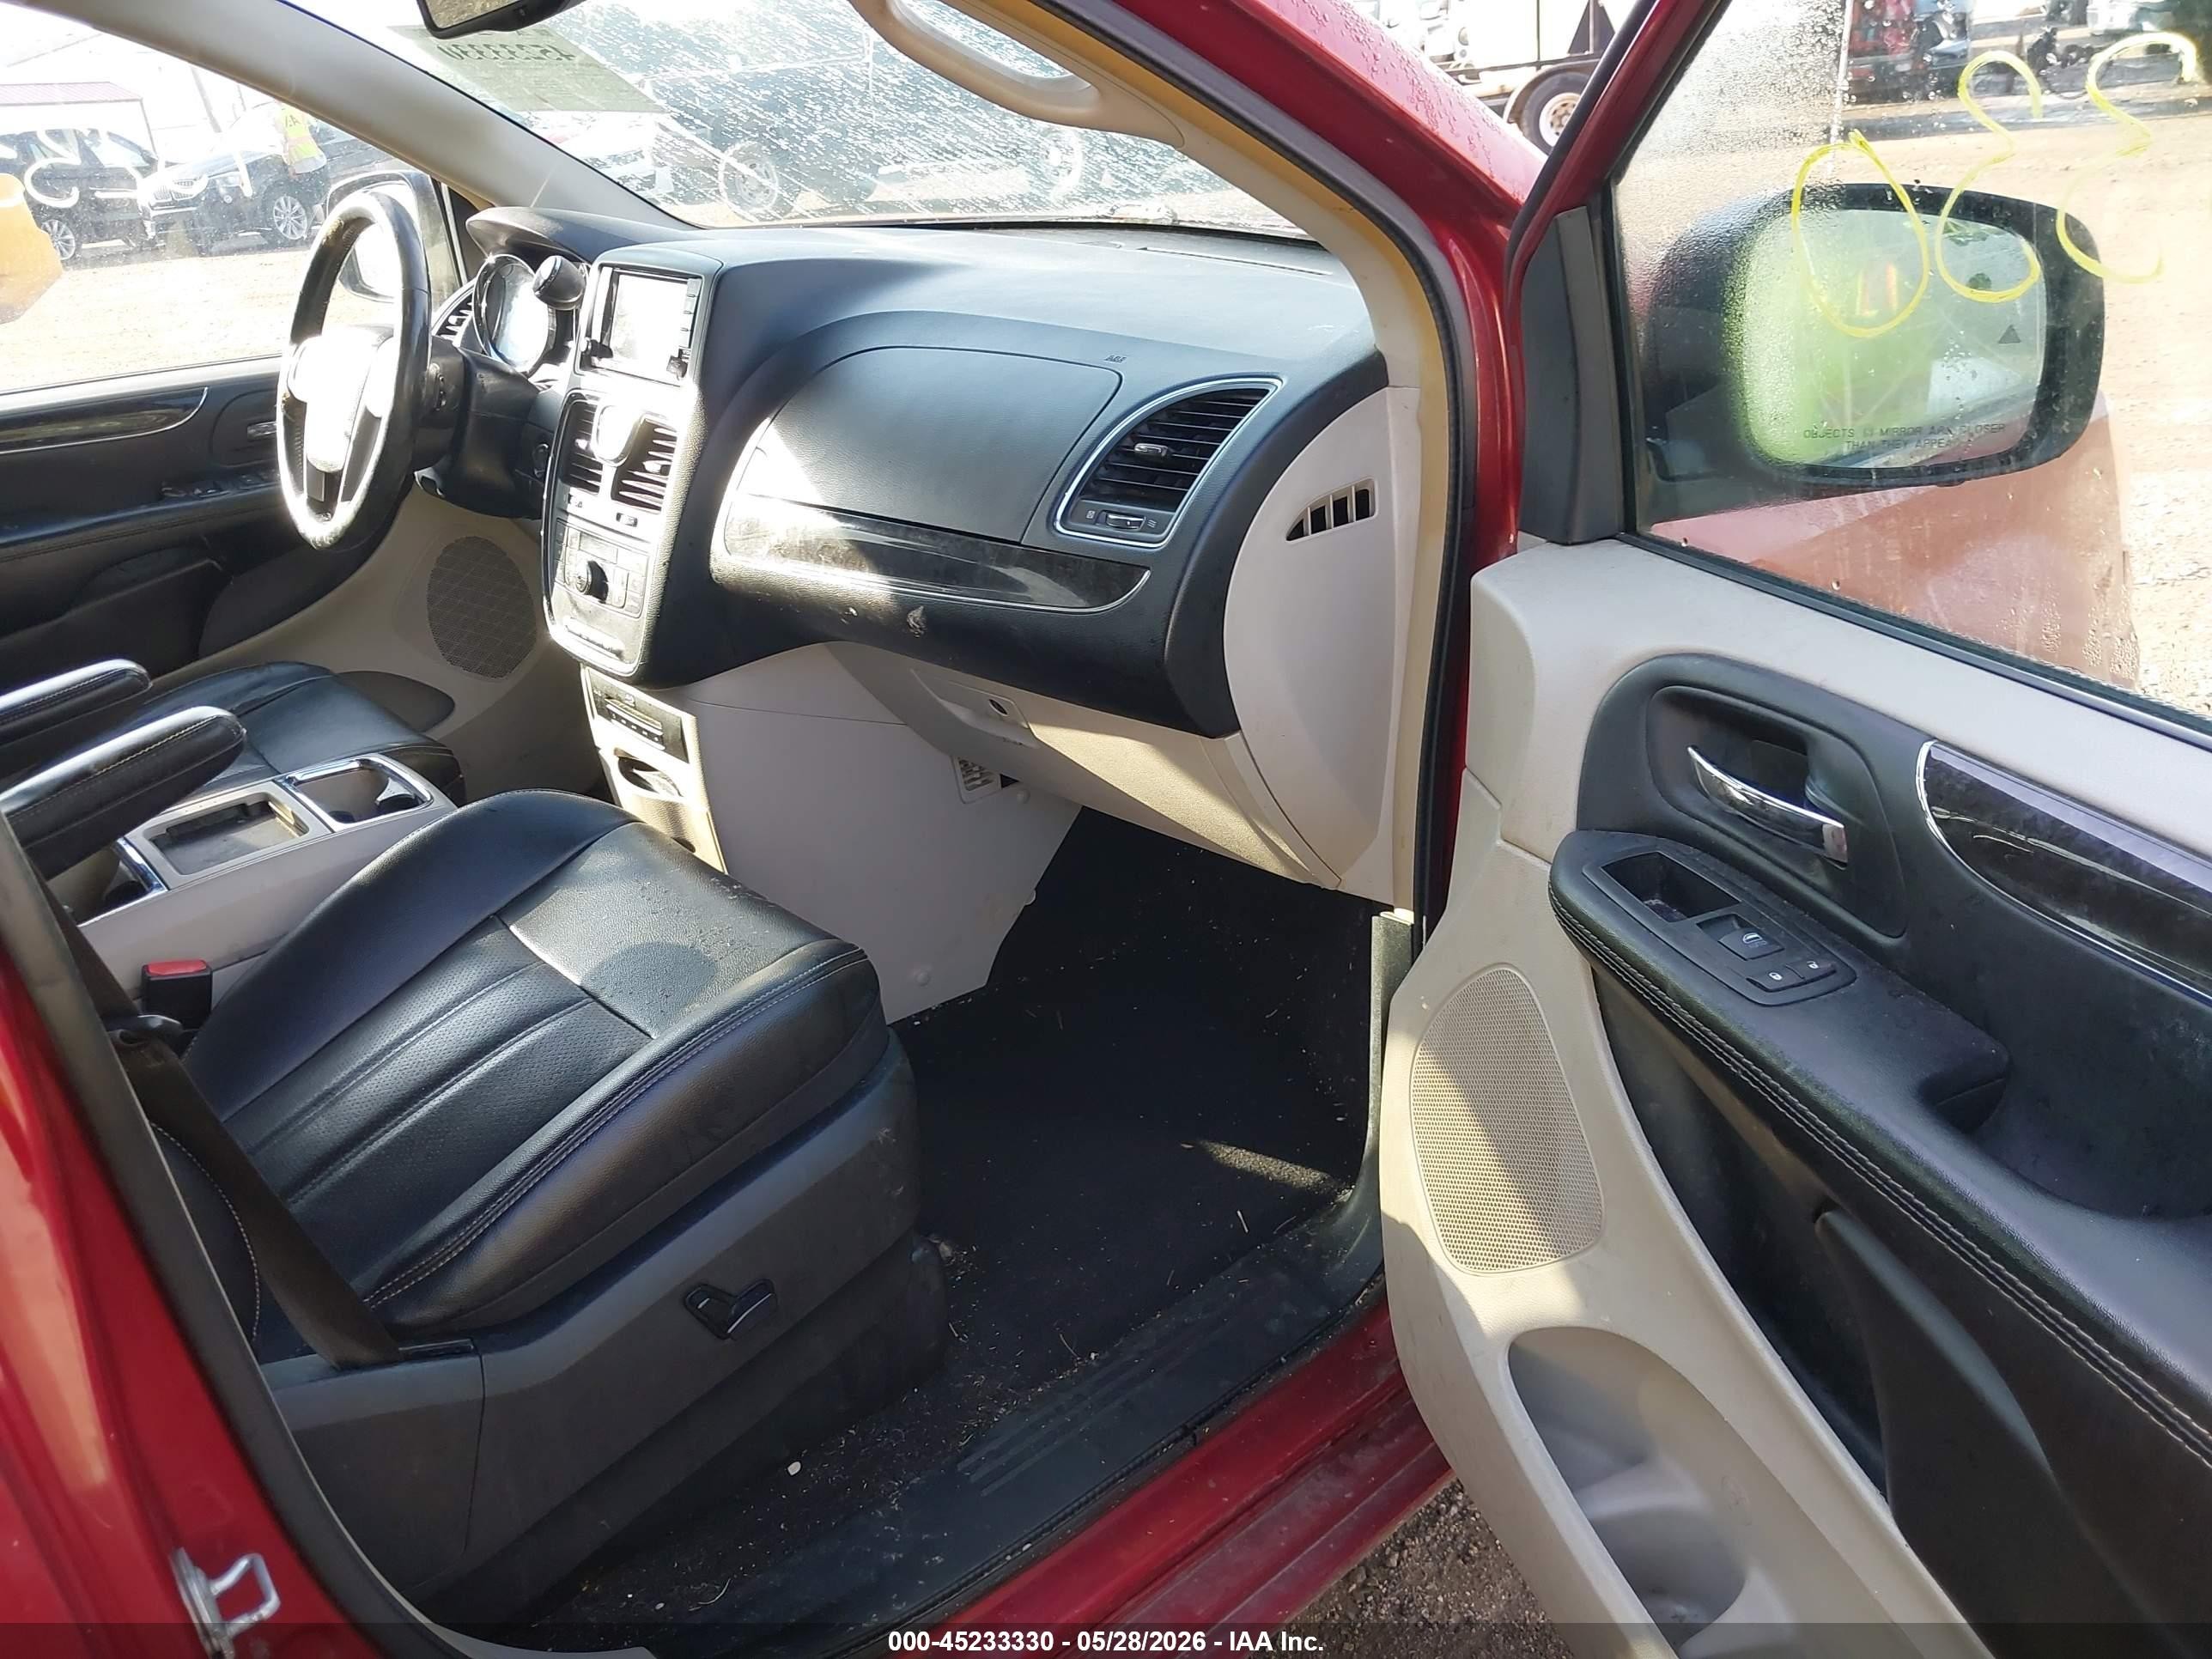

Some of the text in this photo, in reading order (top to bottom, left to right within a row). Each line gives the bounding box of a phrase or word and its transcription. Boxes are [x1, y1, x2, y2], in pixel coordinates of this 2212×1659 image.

[1803, 428, 1855, 439] OBJECTS
[1880, 426, 1923, 436] MIRROR
[1844, 438, 1966, 450] THAN THEY APPEA
